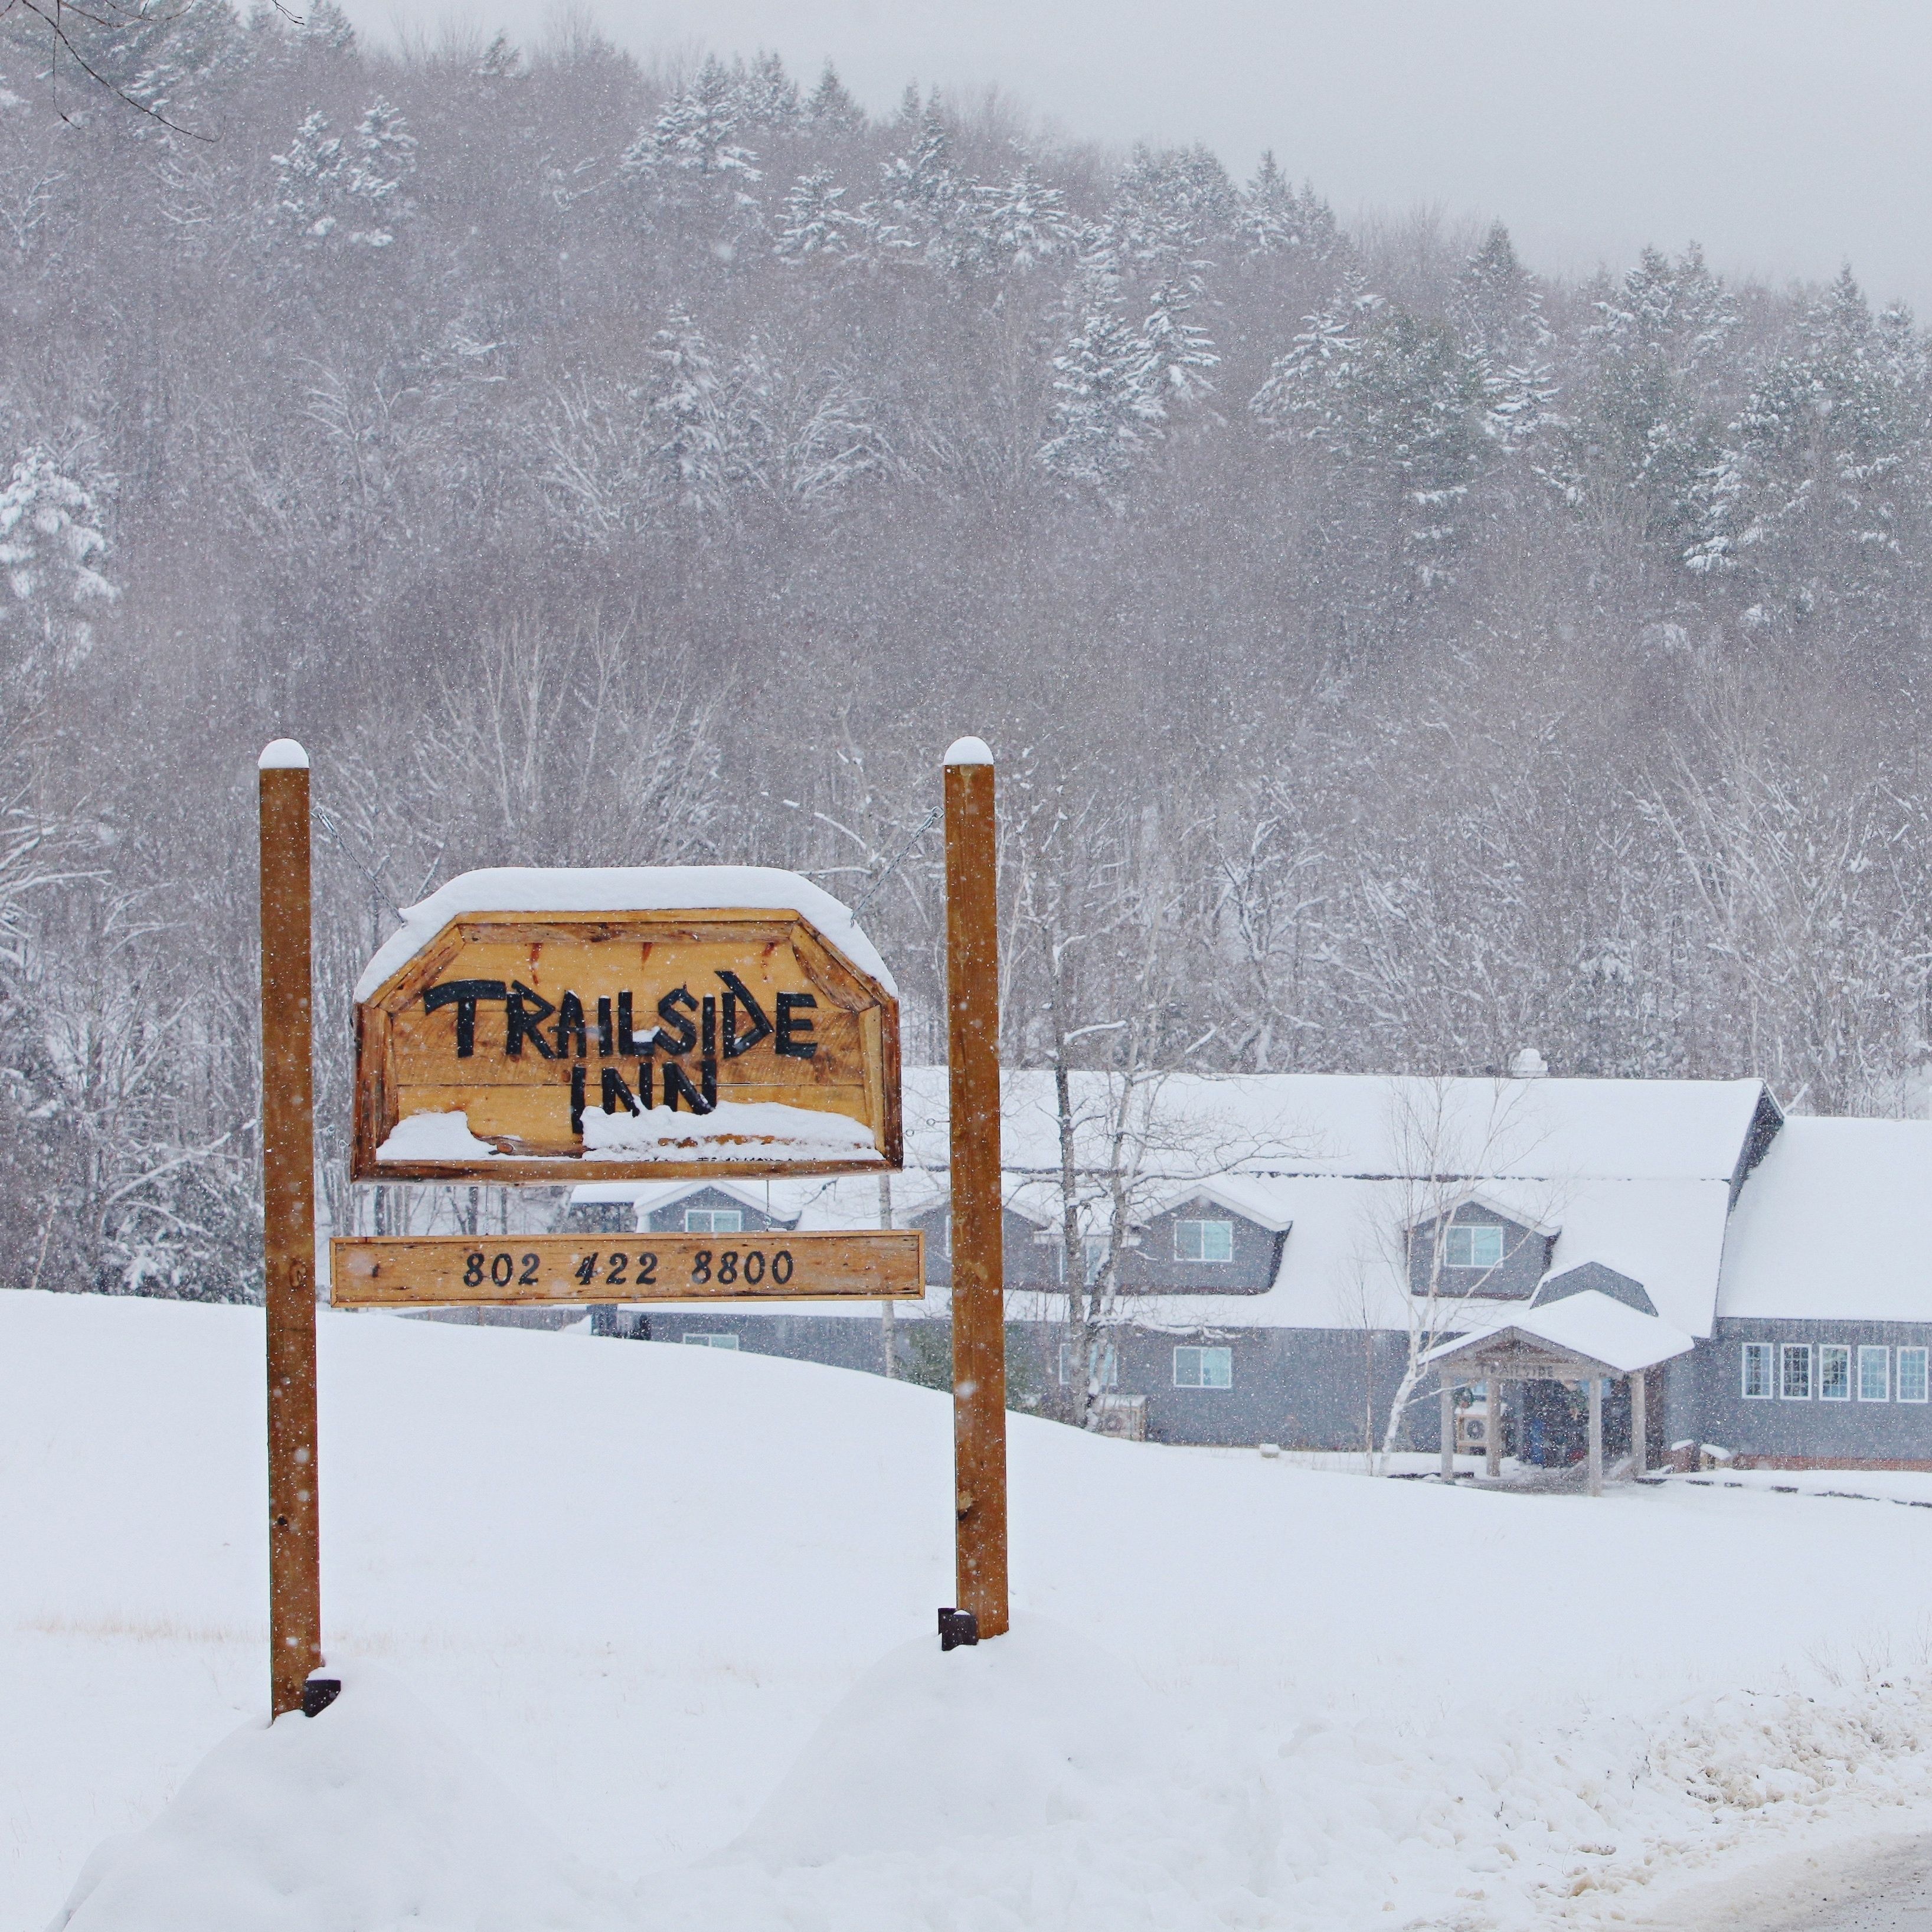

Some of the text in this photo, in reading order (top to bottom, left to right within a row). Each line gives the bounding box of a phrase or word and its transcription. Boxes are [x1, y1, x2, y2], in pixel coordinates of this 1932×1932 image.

[423, 971, 818, 1059] TRAILSIDE
[570, 1061, 717, 1134] INN
[463, 1250, 793, 1287] 802 422 8800
